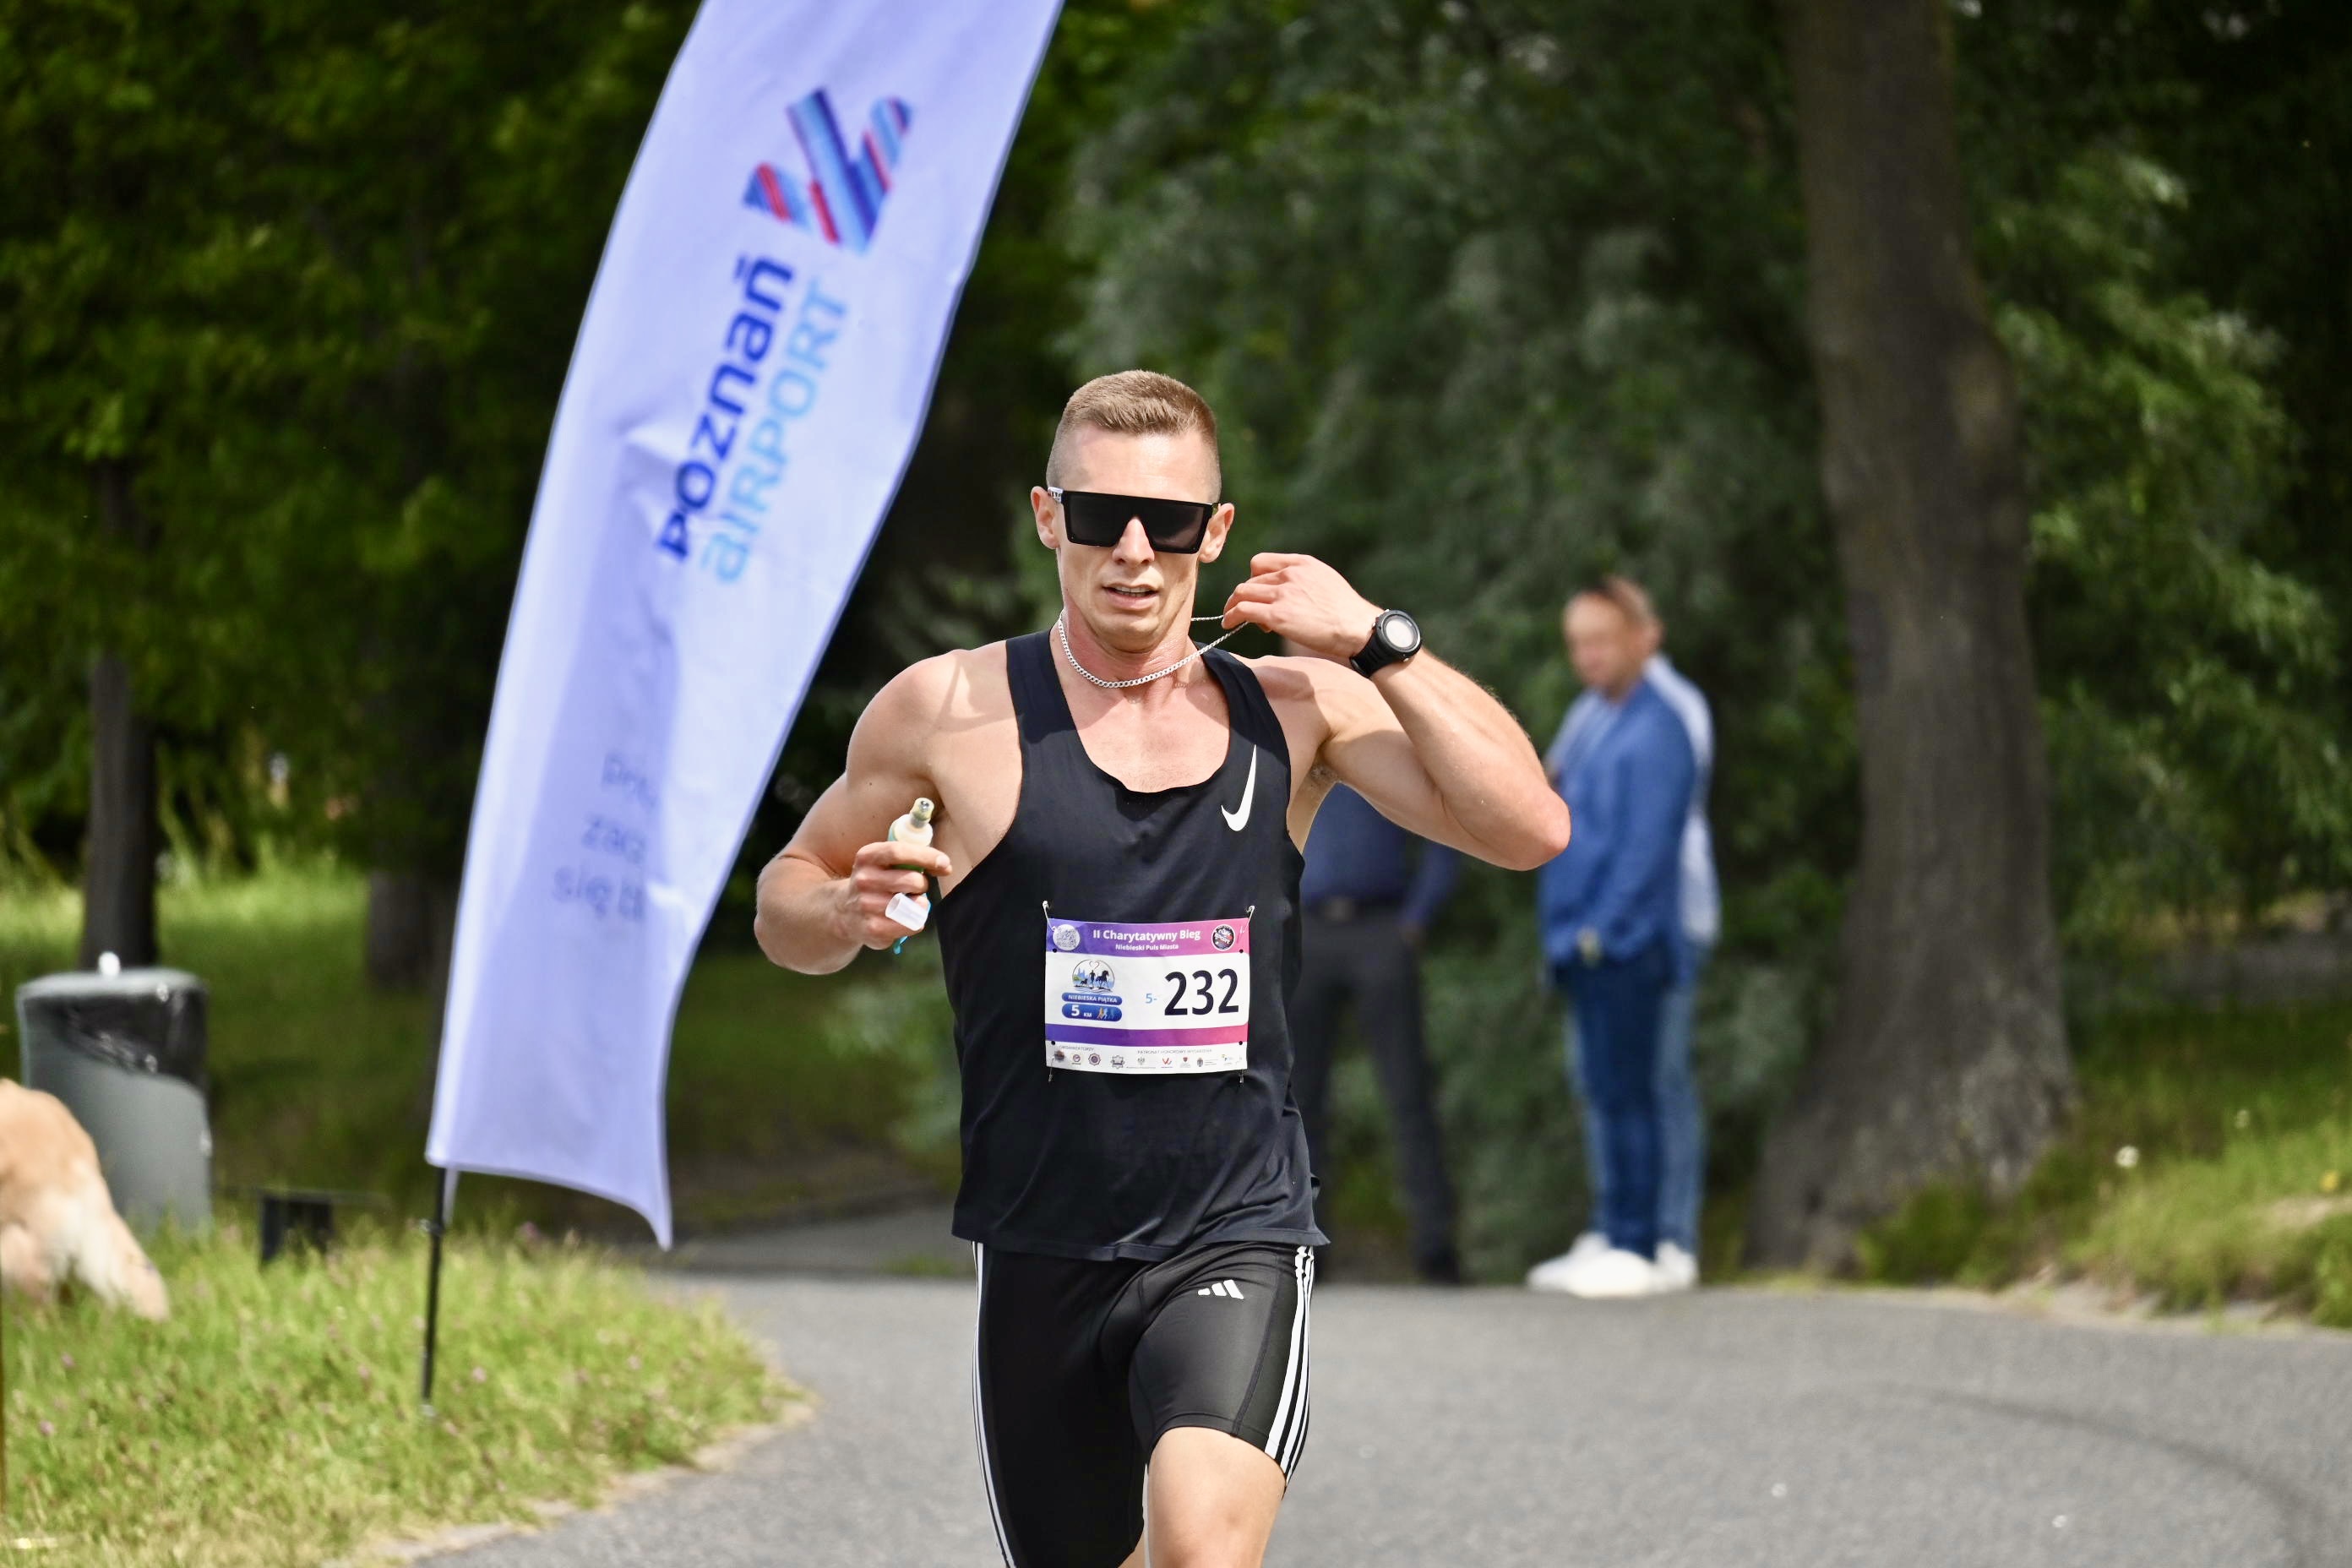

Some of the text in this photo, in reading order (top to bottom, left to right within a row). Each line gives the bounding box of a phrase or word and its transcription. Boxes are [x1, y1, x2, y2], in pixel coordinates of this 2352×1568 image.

[1102, 929, 1178, 943] Charytatywny
[1179, 929, 1200, 940] Bieg
[1164, 968, 1239, 1016] 232
[1071, 1004, 1080, 1016] 5
